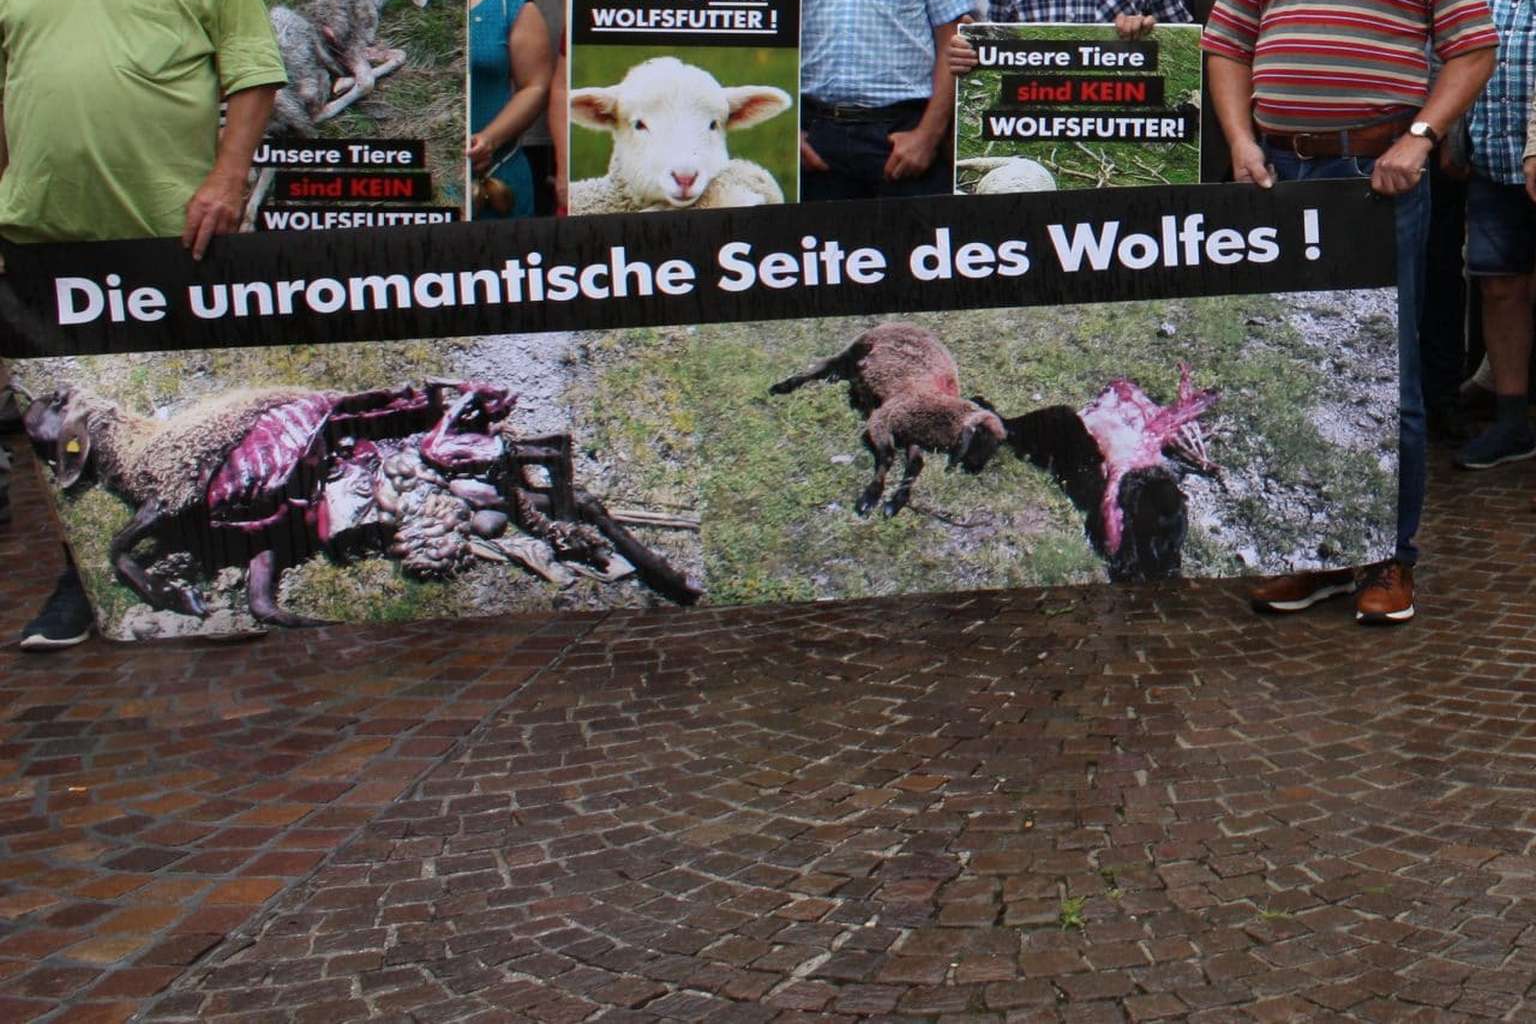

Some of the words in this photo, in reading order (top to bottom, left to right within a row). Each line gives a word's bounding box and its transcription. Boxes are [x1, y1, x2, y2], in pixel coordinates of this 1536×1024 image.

[592, 8, 763, 29] WOLFSFUTTER
[978, 46, 1071, 67] Unsere
[1078, 47, 1145, 67] Tiere
[1017, 81, 1072, 102] sind
[1080, 82, 1146, 102] KEIN
[989, 116, 1185, 138] WOLFSFUTTER!
[253, 144, 341, 164] Unsere
[348, 145, 413, 164] Tiere
[289, 178, 343, 197] sind
[351, 180, 414, 197] KEIN
[56, 274, 167, 325] Die
[187, 247, 697, 320] unromantische
[717, 236, 886, 293] Seite
[909, 228, 1030, 280] des
[1047, 215, 1280, 273] Wolfes
[1303, 209, 1322, 261] !
